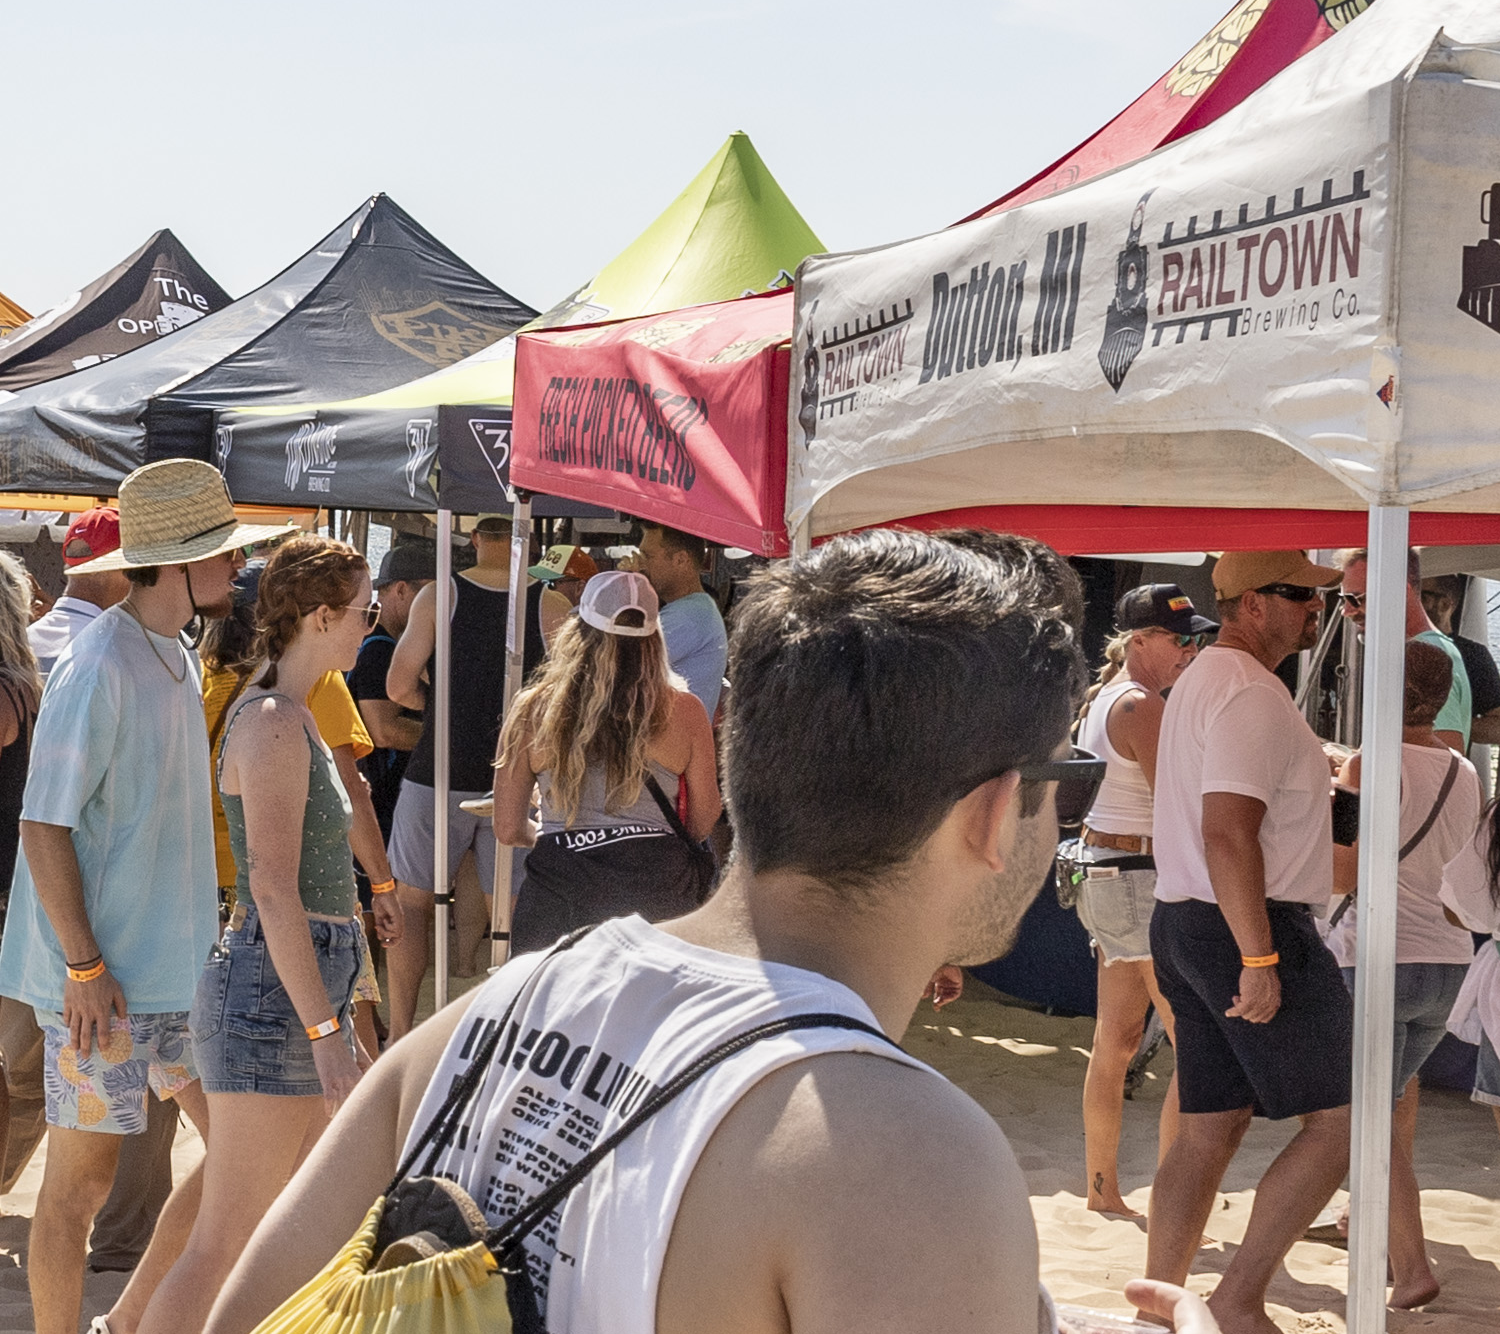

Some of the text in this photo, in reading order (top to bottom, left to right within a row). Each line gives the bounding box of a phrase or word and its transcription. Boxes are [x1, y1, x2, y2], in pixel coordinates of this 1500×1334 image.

[153, 277, 209, 310] The
[1157, 207, 1363, 316] RAILTOWN
[918, 221, 1088, 387] Dutton, MI
[1240, 288, 1361, 337] Brewing Co.
[822, 323, 911, 397] RAILTOWN
[539, 376, 709, 492] FRESH PICKED BEERS
[565, 828, 607, 849] FOOT
